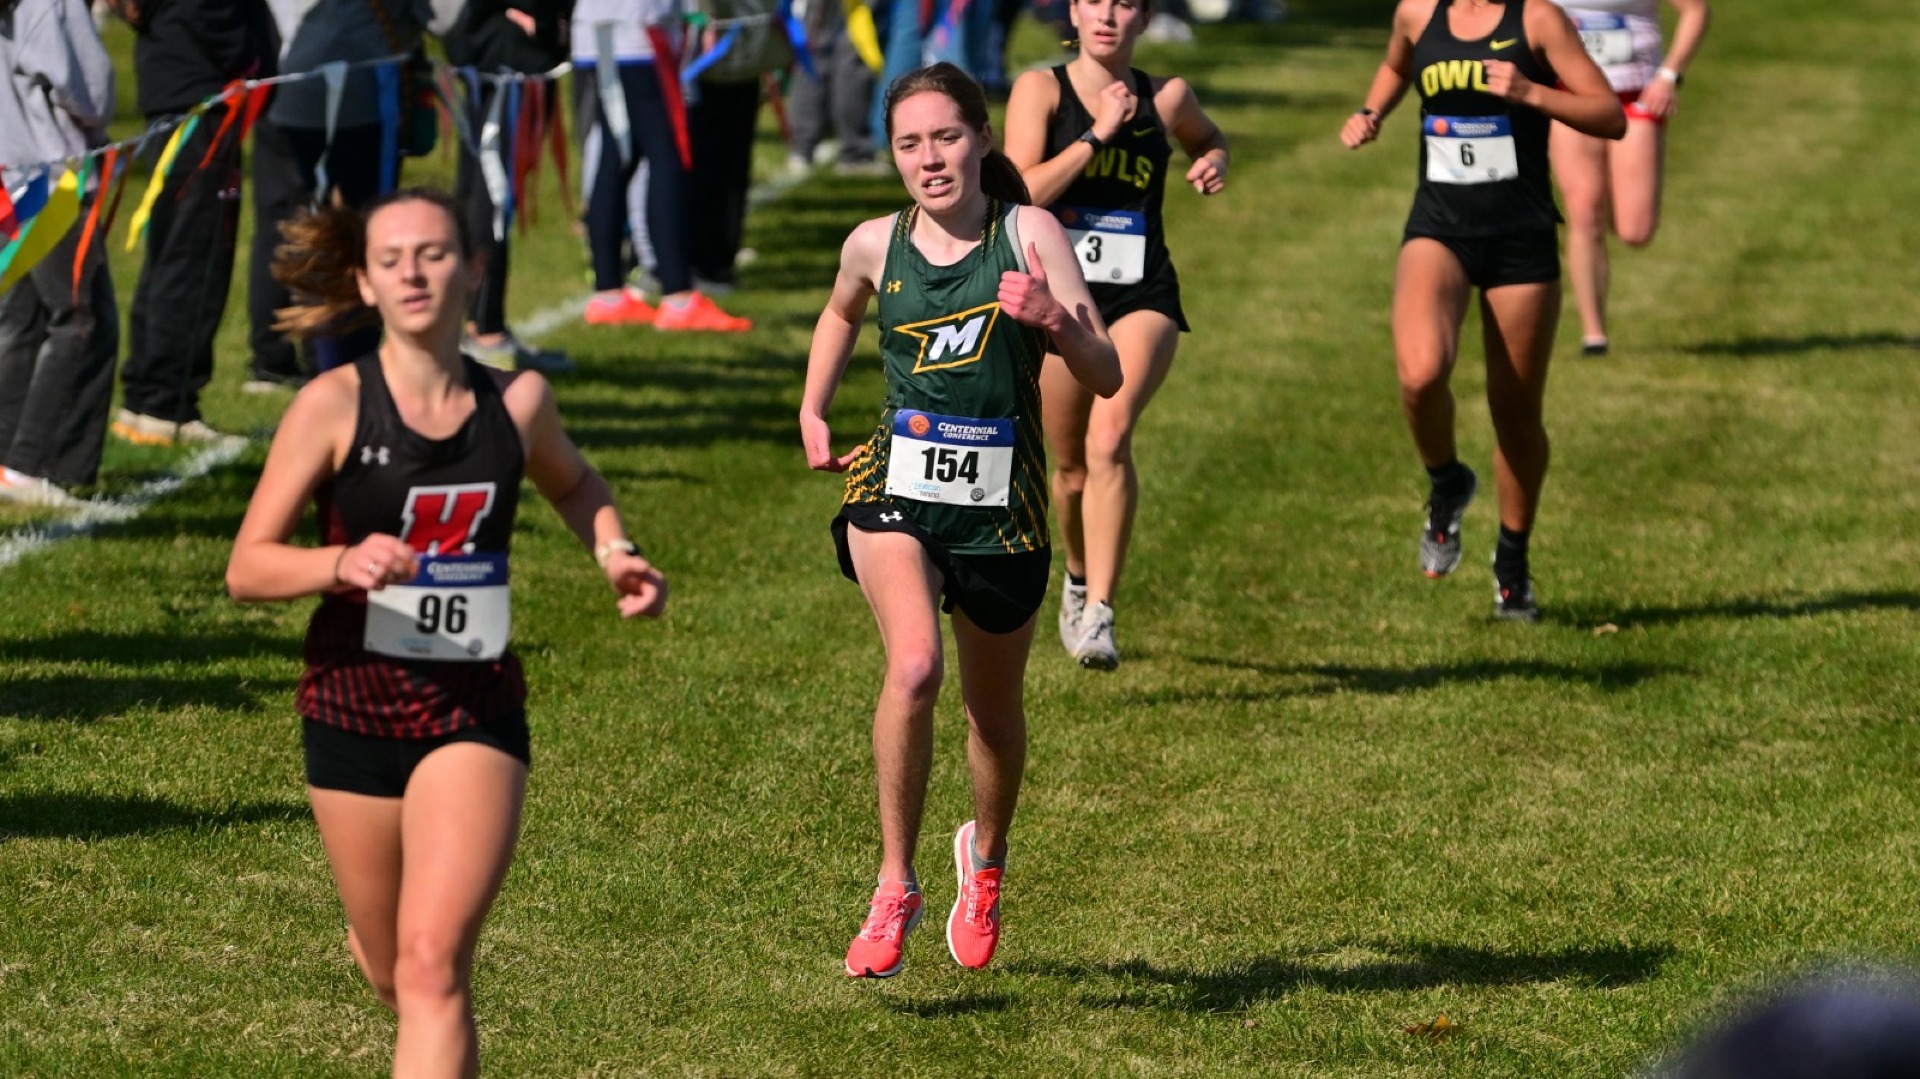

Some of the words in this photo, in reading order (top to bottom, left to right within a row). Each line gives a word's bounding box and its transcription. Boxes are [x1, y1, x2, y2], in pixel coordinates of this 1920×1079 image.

[1421, 59, 1488, 97] OWL
[1084, 147, 1154, 189] WLS
[1460, 143, 1475, 167] 6
[1086, 236, 1102, 263] 3
[927, 315, 987, 361] M
[938, 422, 998, 435] CENTENNIAL
[943, 432, 989, 441] CONFERENCE
[921, 446, 979, 485] 154
[401, 482, 496, 557] H
[415, 594, 468, 634] 96
